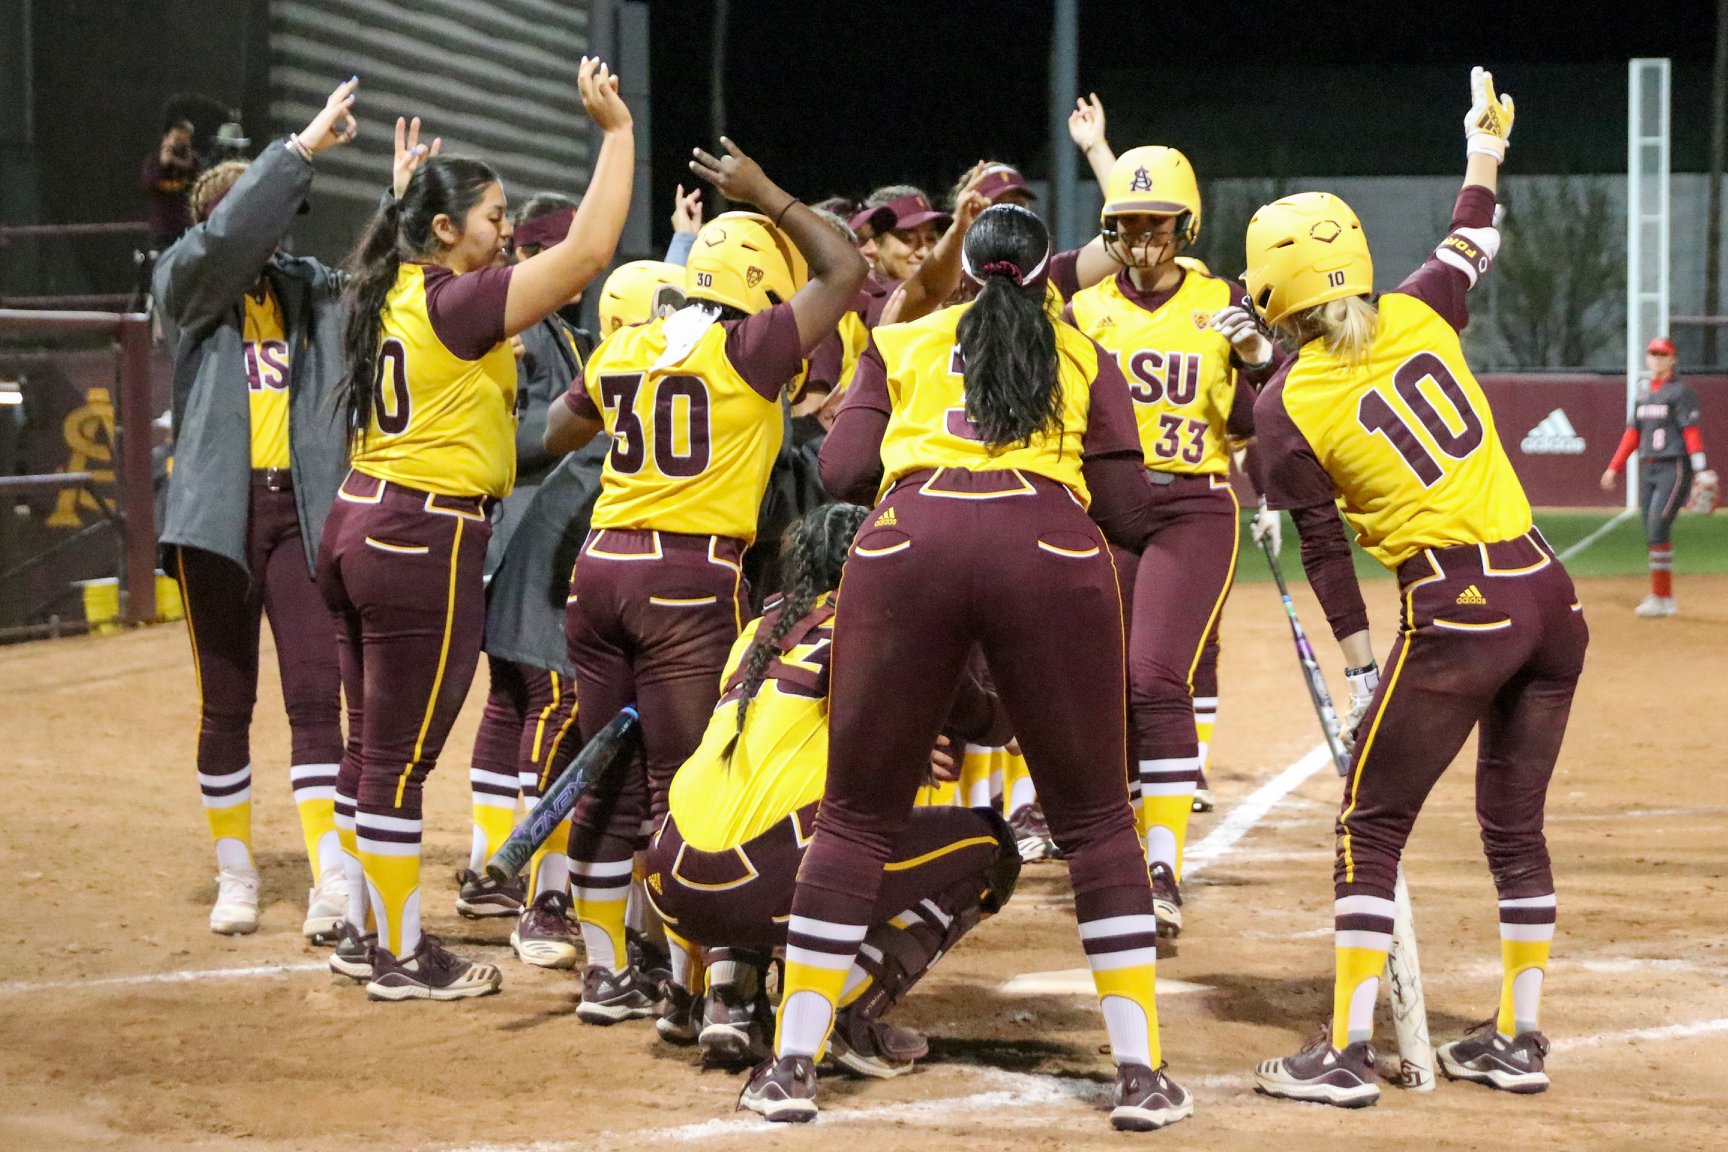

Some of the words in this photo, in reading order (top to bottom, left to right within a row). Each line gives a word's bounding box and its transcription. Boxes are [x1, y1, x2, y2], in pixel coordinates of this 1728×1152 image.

[697, 272, 713, 288] 30
[1327, 271, 1345, 288] 10
[1108, 348, 1202, 407] SU
[599, 373, 712, 478] 30
[1358, 351, 1484, 488] 10
[1154, 412, 1210, 464] 33
[874, 518, 897, 528] adidas
[1456, 596, 1487, 605] adidas
